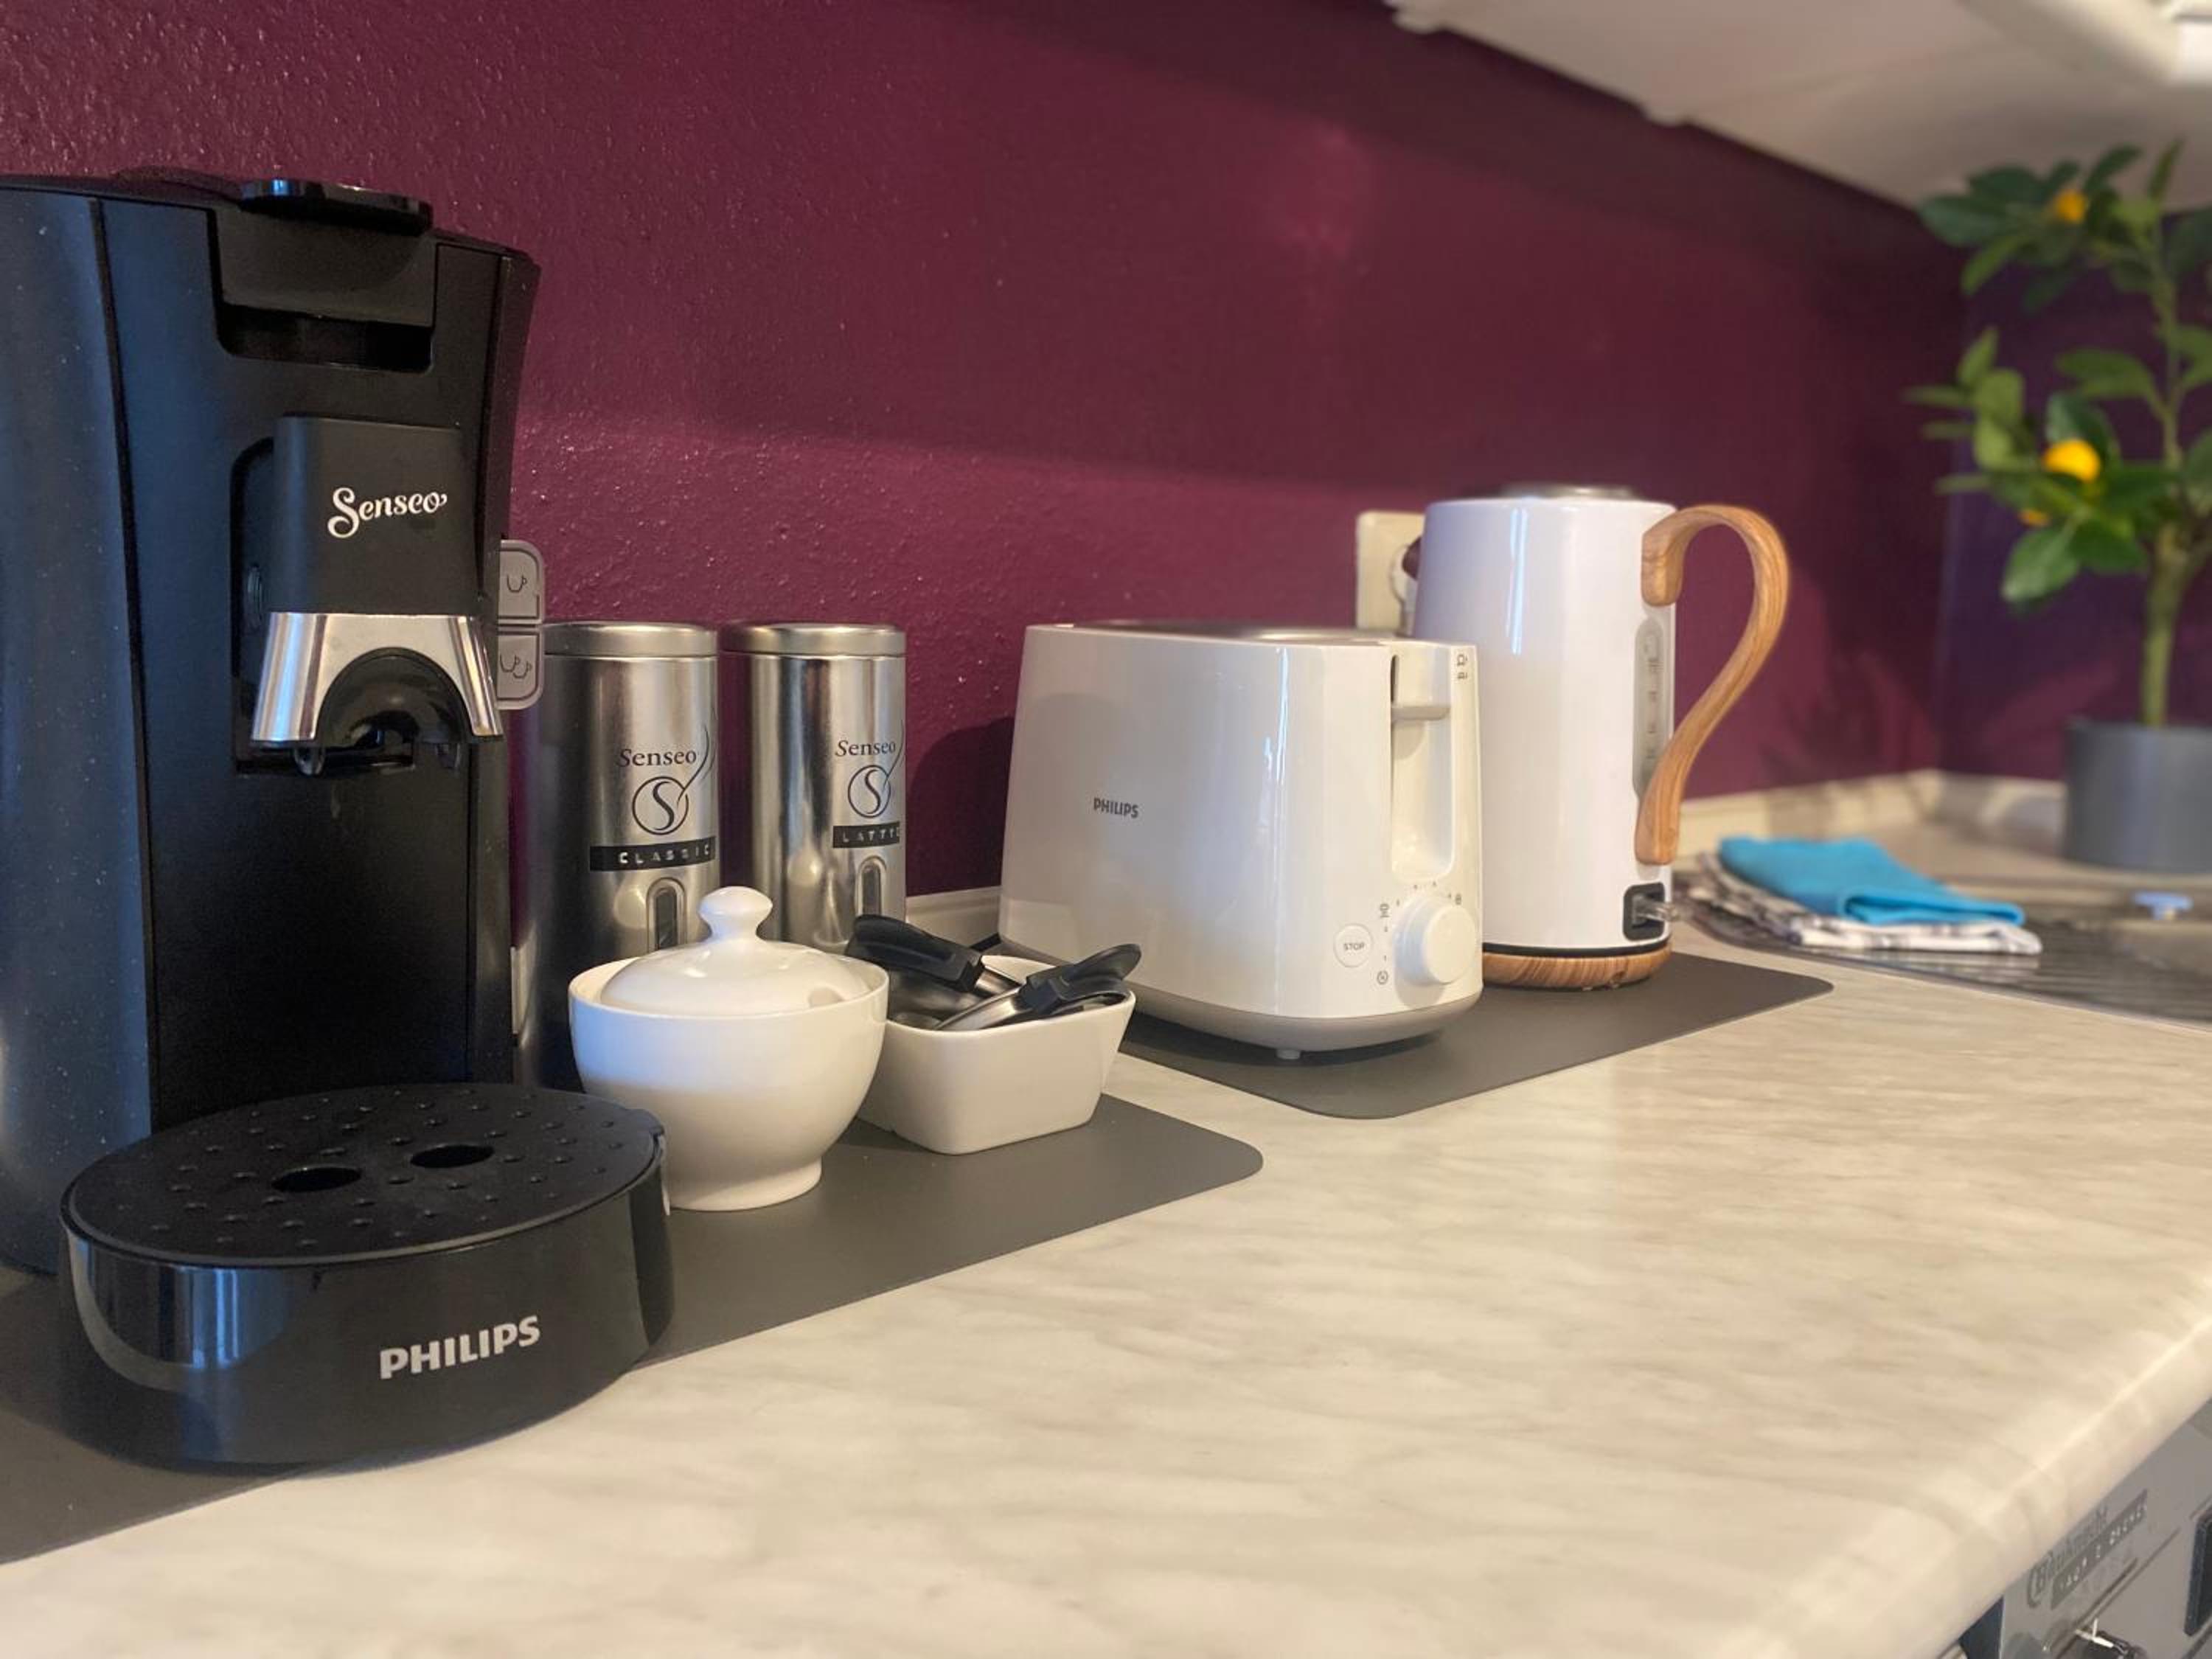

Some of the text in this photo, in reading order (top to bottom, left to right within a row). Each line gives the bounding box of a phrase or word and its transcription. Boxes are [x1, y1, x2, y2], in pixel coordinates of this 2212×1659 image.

[327, 487, 448, 539] Senseo
[616, 748, 697, 768] Senseo
[835, 740, 896, 757] Senseo
[1093, 797, 1139, 818] PHILIPS
[619, 844, 710, 864] CLASSIC
[1343, 942, 1366, 951] STOP
[380, 1315, 540, 1380] PHILIPS
